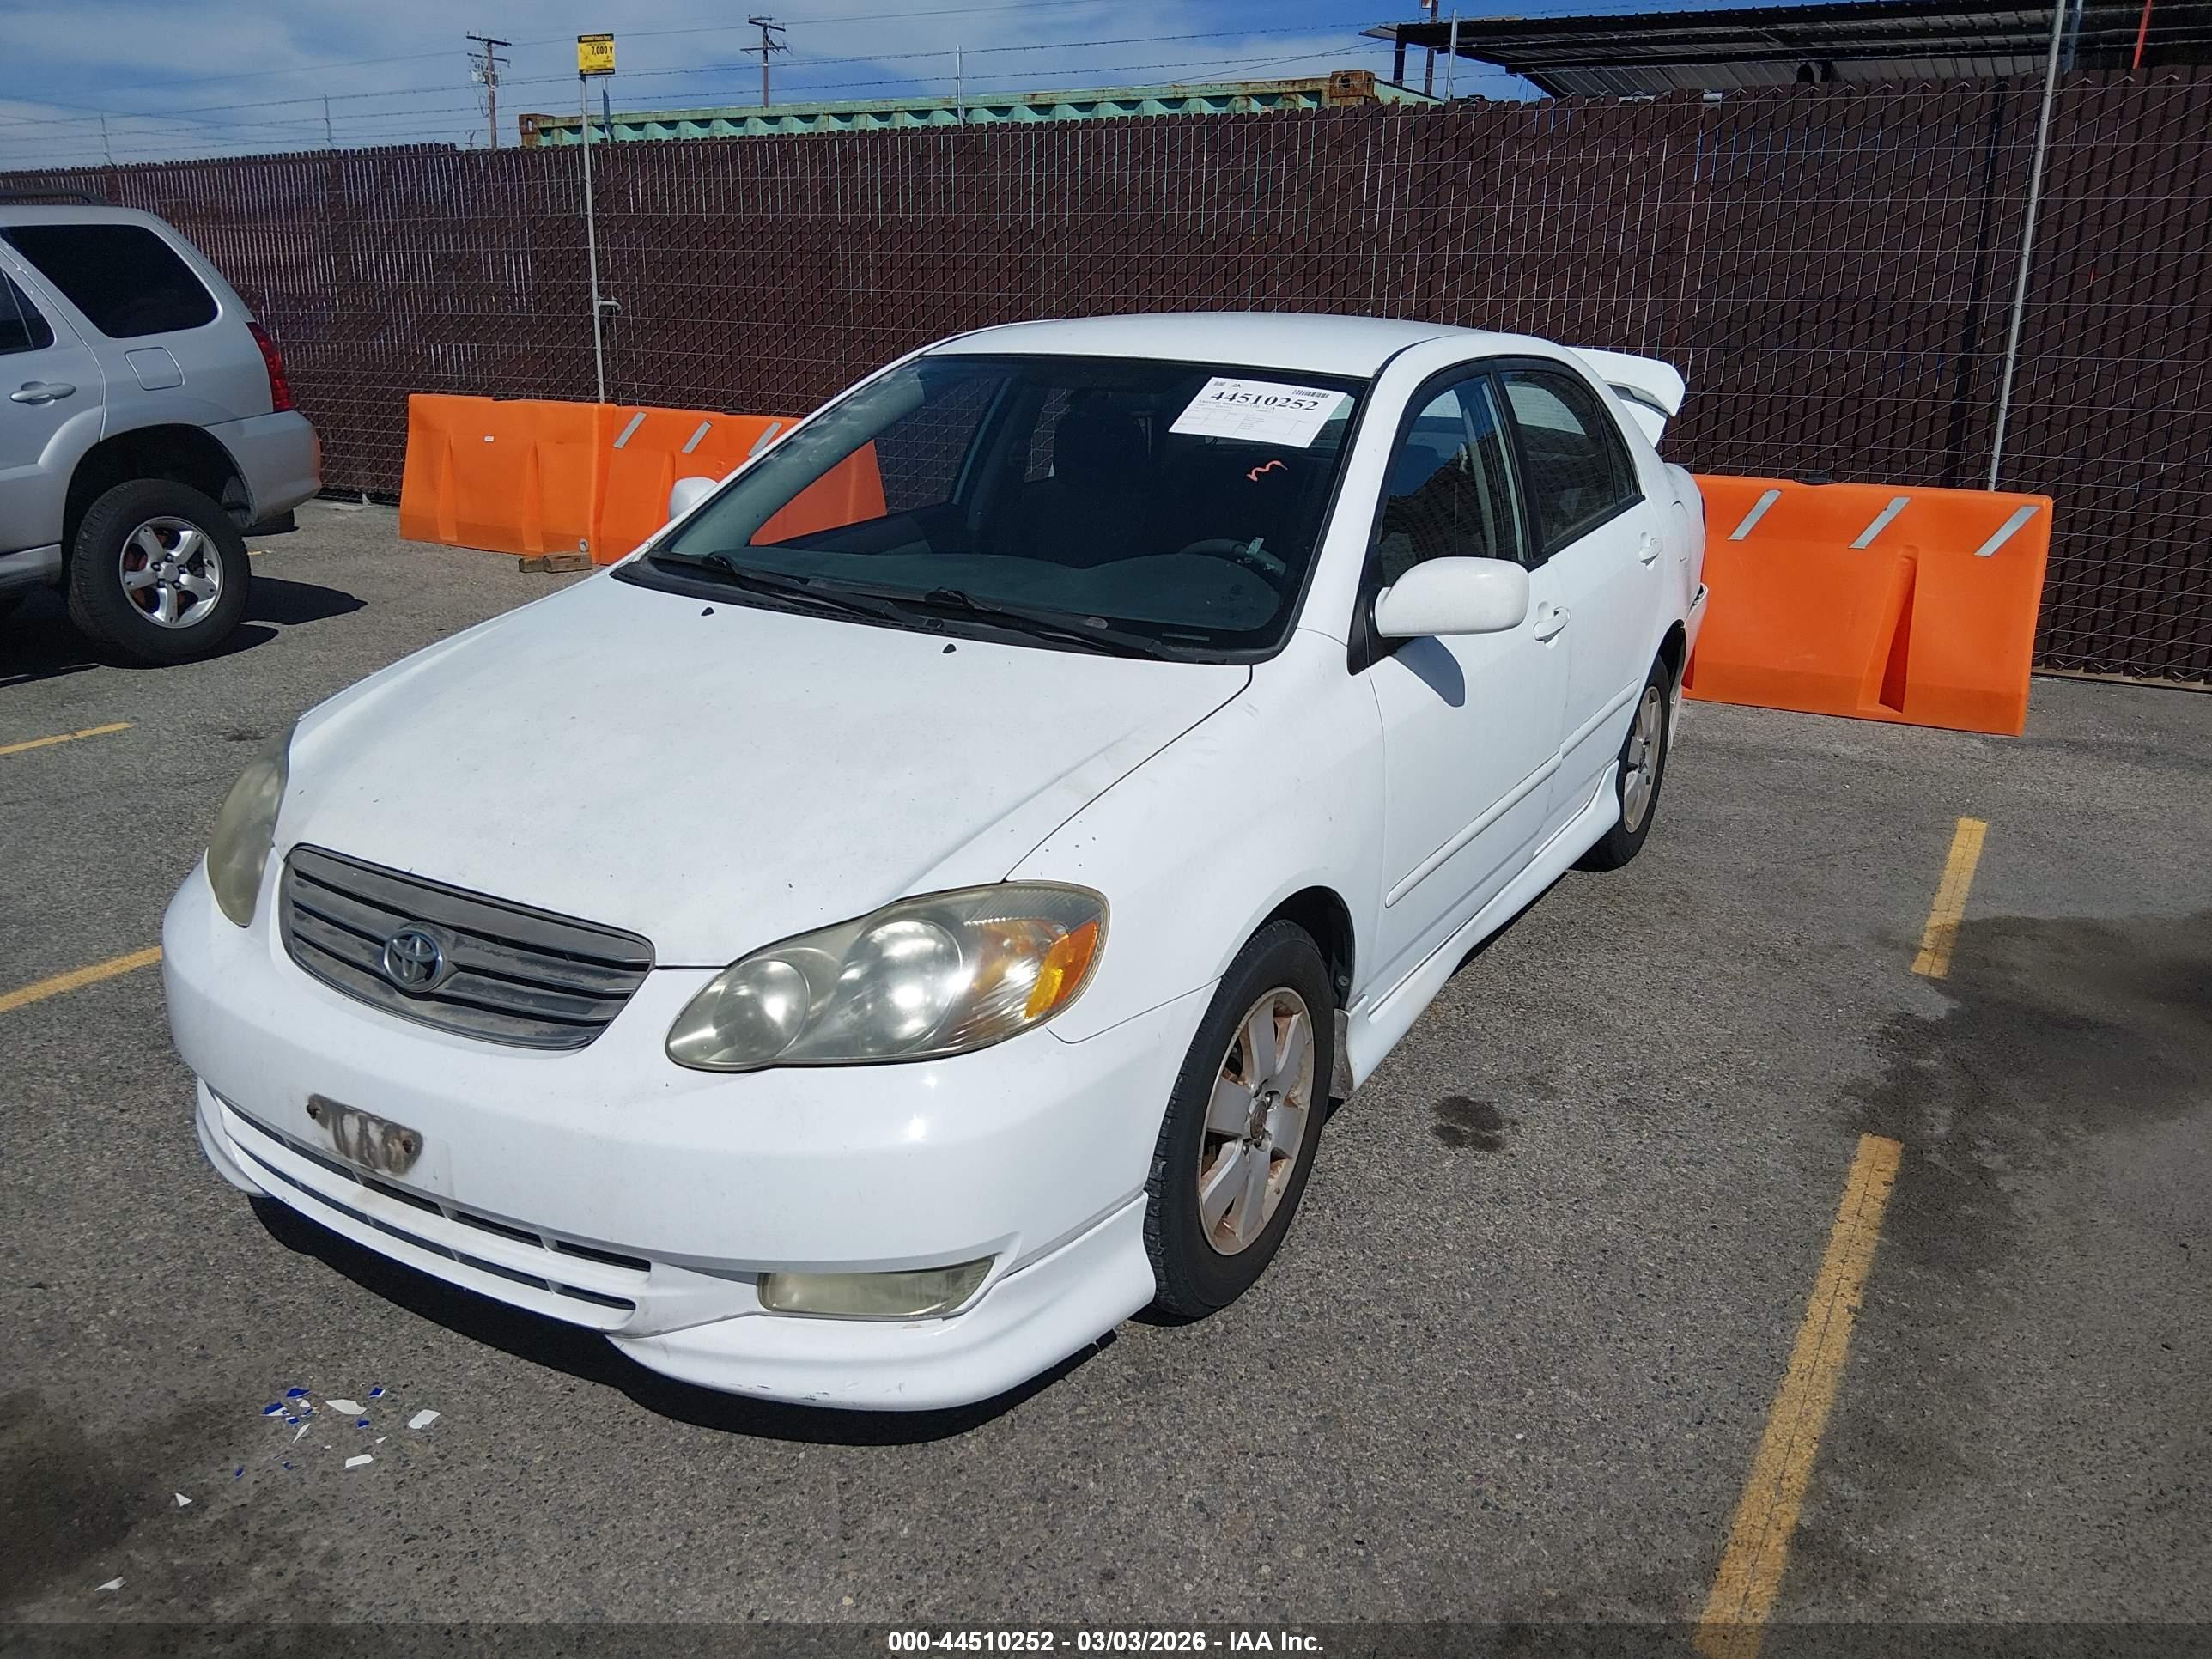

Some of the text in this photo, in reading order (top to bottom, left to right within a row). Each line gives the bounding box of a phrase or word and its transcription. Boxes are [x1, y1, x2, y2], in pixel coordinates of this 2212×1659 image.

[591, 46, 613, 56] 7,000 V
[1211, 391, 1318, 411] 44510252
